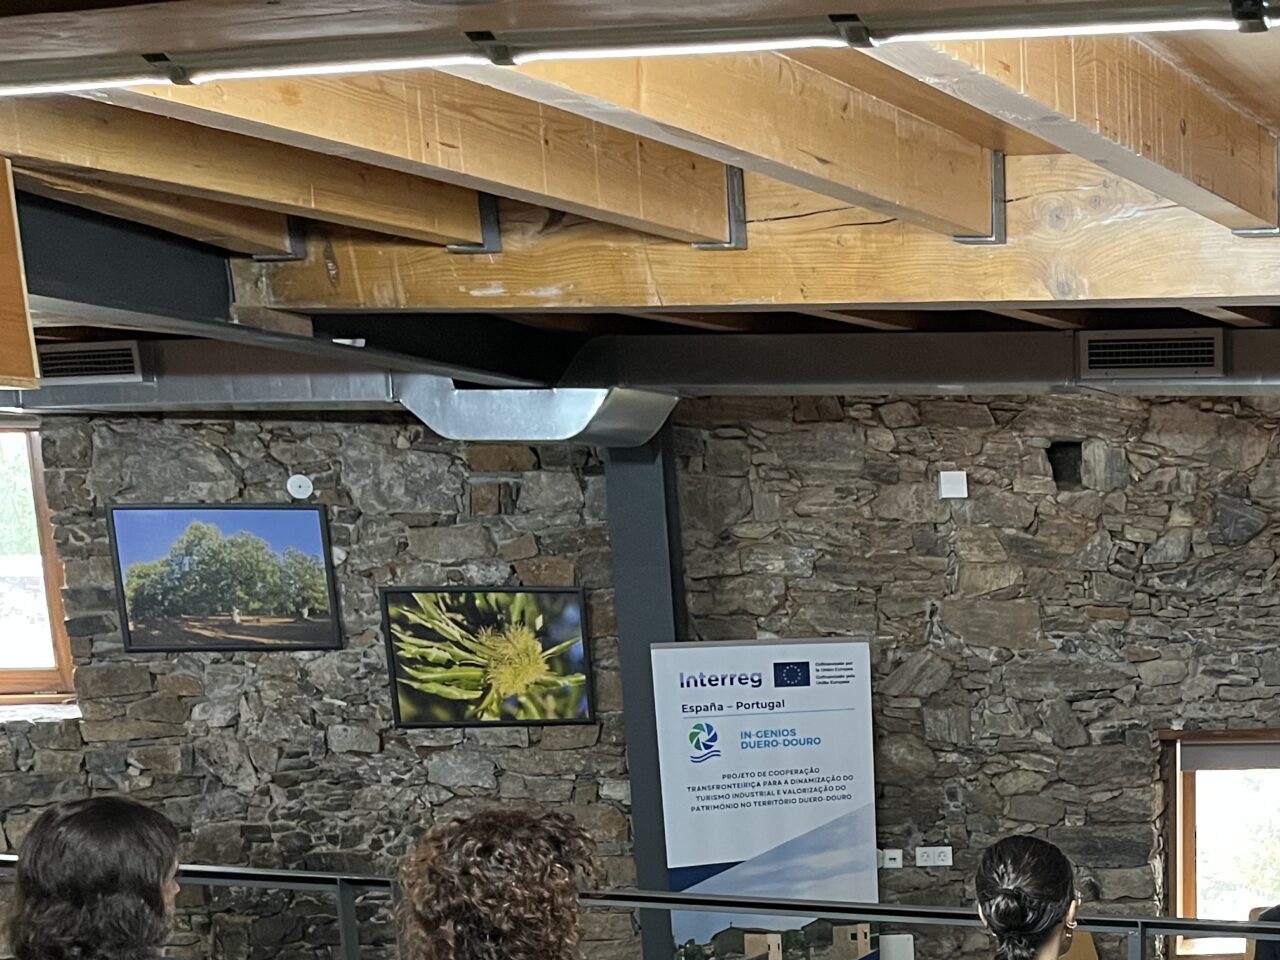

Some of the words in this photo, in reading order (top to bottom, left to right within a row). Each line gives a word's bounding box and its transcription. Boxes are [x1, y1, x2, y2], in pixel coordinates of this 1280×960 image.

[680, 672, 762, 688] Interreg
[681, 702, 724, 714] España
[736, 699, 785, 710] Portugal
[740, 728, 797, 739] IN-GENIOS
[740, 737, 822, 749] DUERO-DOURO
[722, 771, 756, 780] PROJETO
[768, 767, 820, 776] COOPERAÇÃO
[687, 781, 761, 792] TRANSFRONTEIRIÇA
[790, 775, 841, 785] DINAMIZAÇÃO
[695, 793, 730, 802] TURISMO
[732, 790, 775, 799] INDUSTRIAL
[783, 785, 834, 795] VALORIZAÇÃO
[754, 797, 797, 807] TERRITÓRIO
[799, 794, 852, 804] DUERO-DOURO
